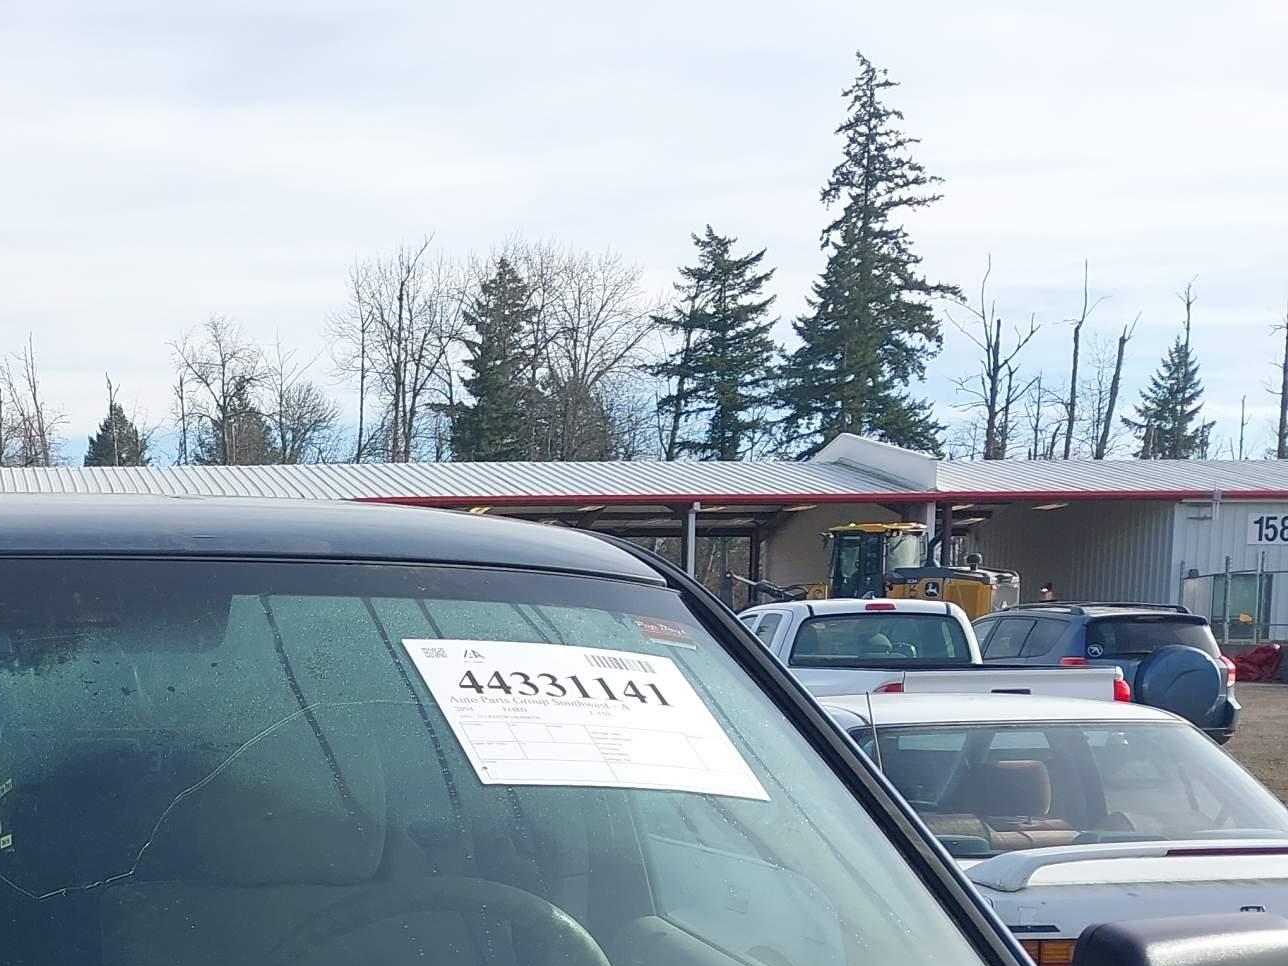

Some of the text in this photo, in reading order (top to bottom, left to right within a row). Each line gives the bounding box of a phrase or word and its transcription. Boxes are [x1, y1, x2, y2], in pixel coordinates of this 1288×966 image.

[458, 669, 675, 707] 44331141
[450, 695, 478, 704] Auto
[479, 696, 511, 704] Parts
[512, 697, 550, 707] Group
[620, 703, 631, 711] A
